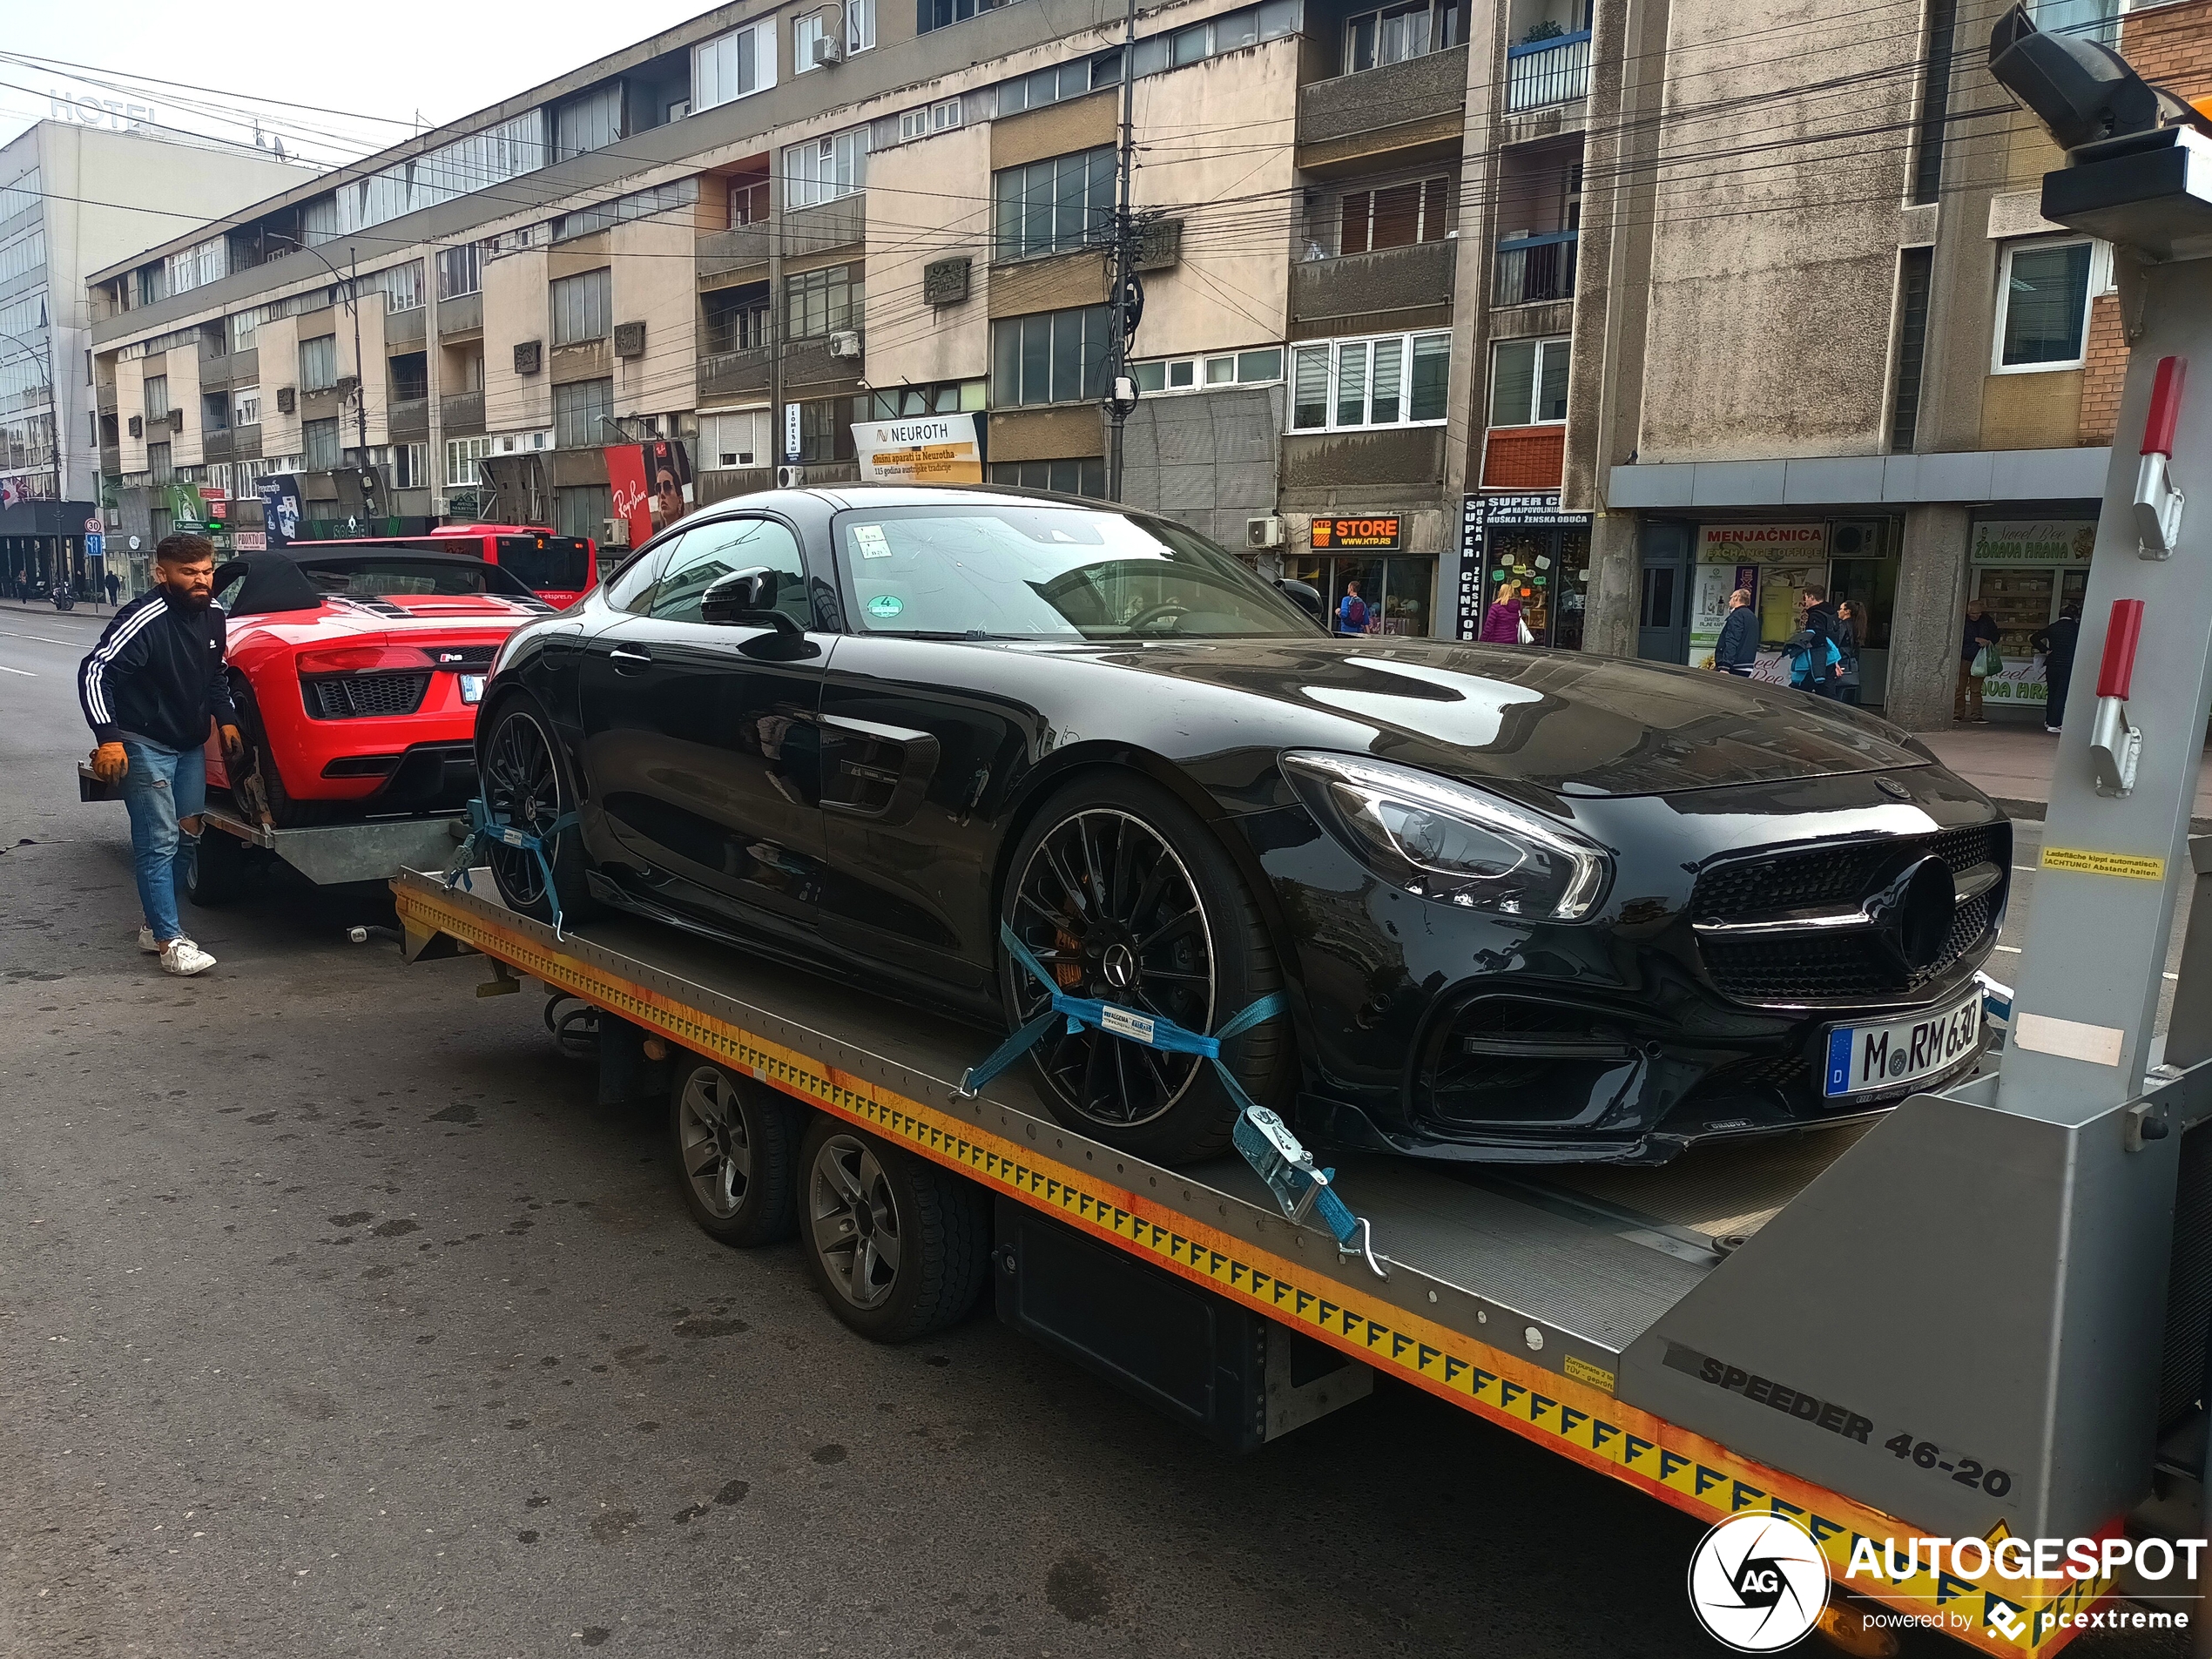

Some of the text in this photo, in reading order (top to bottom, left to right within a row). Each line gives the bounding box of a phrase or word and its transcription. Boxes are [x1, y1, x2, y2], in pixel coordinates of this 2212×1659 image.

[51, 89, 165, 137] HOTEL
[891, 423, 948, 442] NEUROTH
[873, 454, 892, 463] Slušni
[892, 452, 914, 465] aparati
[915, 451, 921, 461] iz
[884, 466, 901, 476] godina
[902, 464, 927, 475] austrijske
[928, 463, 952, 473] tradicije
[1488, 497, 1541, 506] SUPER
[1524, 515, 1556, 523] ŽENSKA
[1557, 515, 1588, 523] OBUĆA
[1336, 520, 1398, 536] STORE
[1463, 501, 1475, 557] SUPER
[1707, 527, 1822, 542] MENJAČNICA
[1992, 524, 2066, 542] Sweet Bee
[537, 539, 543, 550] 2
[1707, 547, 1822, 557] EXCHANGE OFFICE
[1975, 542, 2068, 558] ZDRAVA HRANA
[880, 597, 891, 606] 4
[1460, 571, 1472, 617] CENE
[2046, 850, 2161, 868] Ladefläche kippt automatisch.
[2093, 864, 2128, 873] Abstand
[2130, 868, 2159, 877] halten.
[1833, 1069, 1843, 1083] D
[1864, 1030, 1890, 1082] M
[1566, 1357, 1600, 1375] Zurrpunkte
[1566, 1365, 1581, 1375] TÜV
[1587, 1375, 1613, 1390] geprüft
[1698, 1356, 2013, 1498] SPEEDER 46-20
